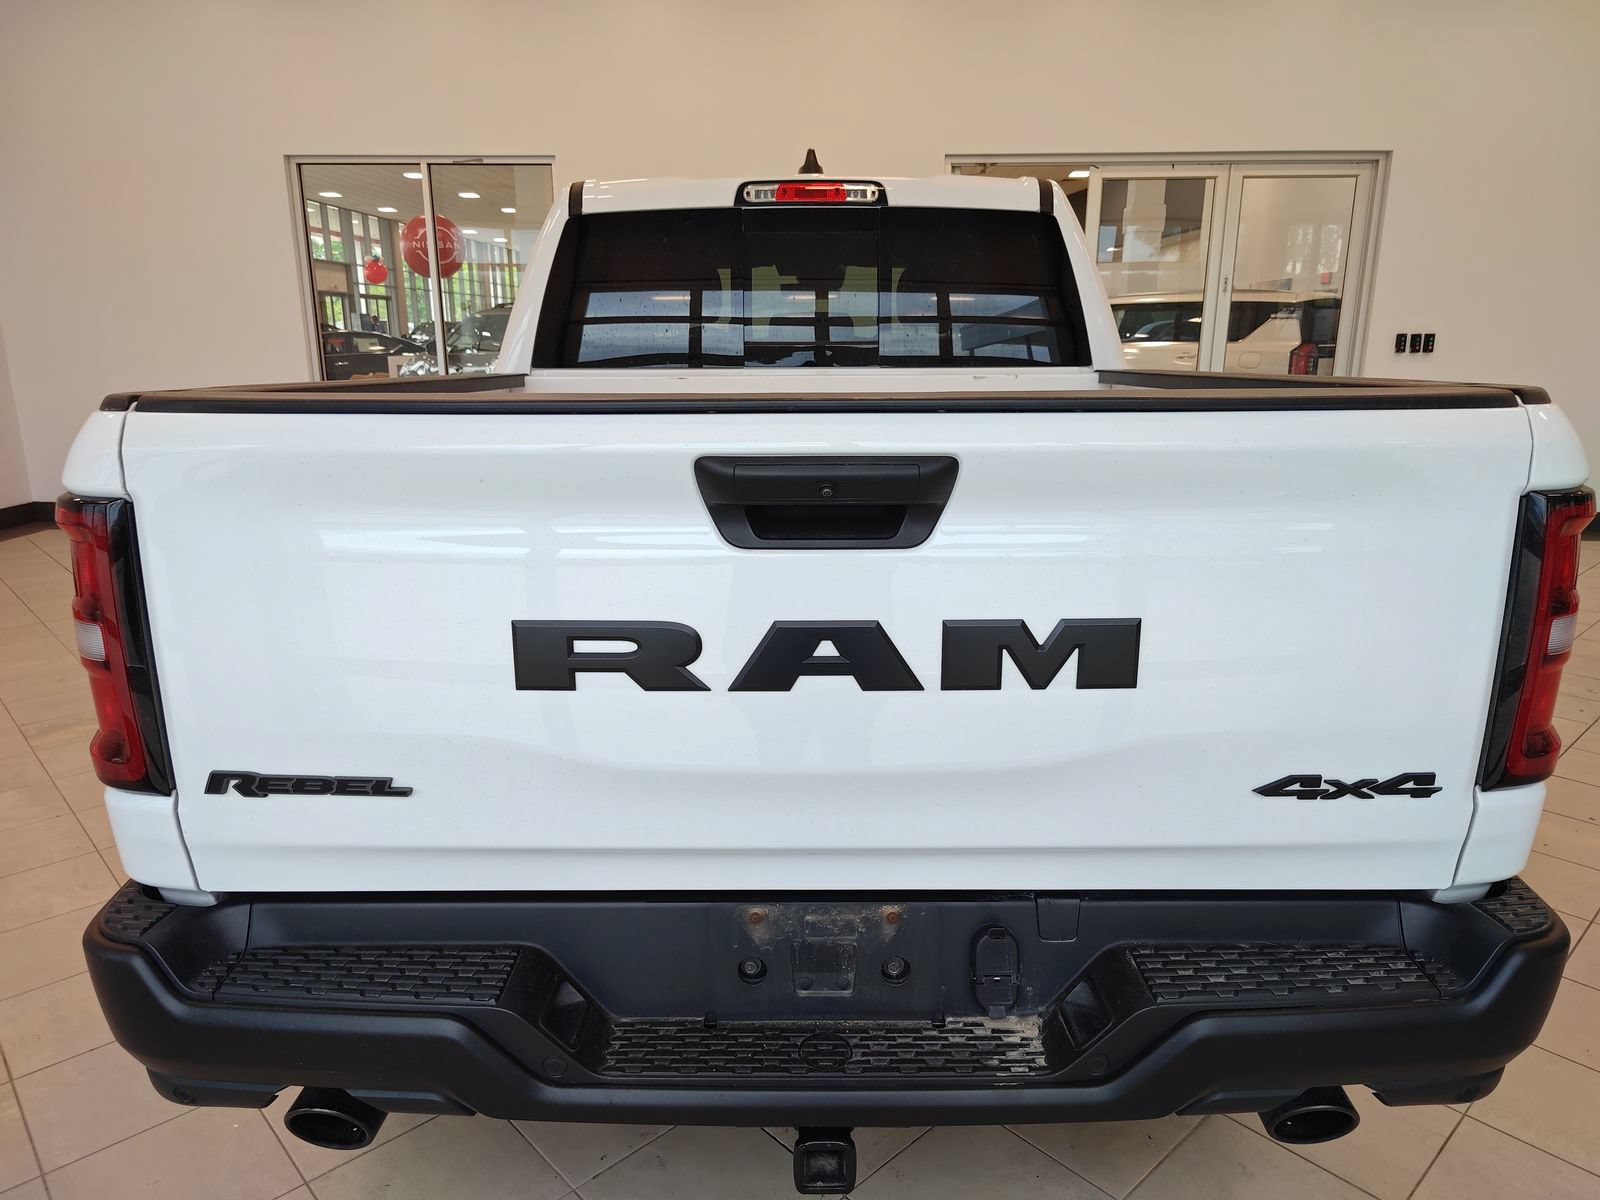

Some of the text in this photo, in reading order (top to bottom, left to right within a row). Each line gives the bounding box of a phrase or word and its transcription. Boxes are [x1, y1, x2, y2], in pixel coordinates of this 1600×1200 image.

[412, 240, 460, 249] NISAN
[511, 618, 1142, 692] RAM
[204, 769, 414, 798] REBEL
[1251, 771, 1443, 800] 4x4
